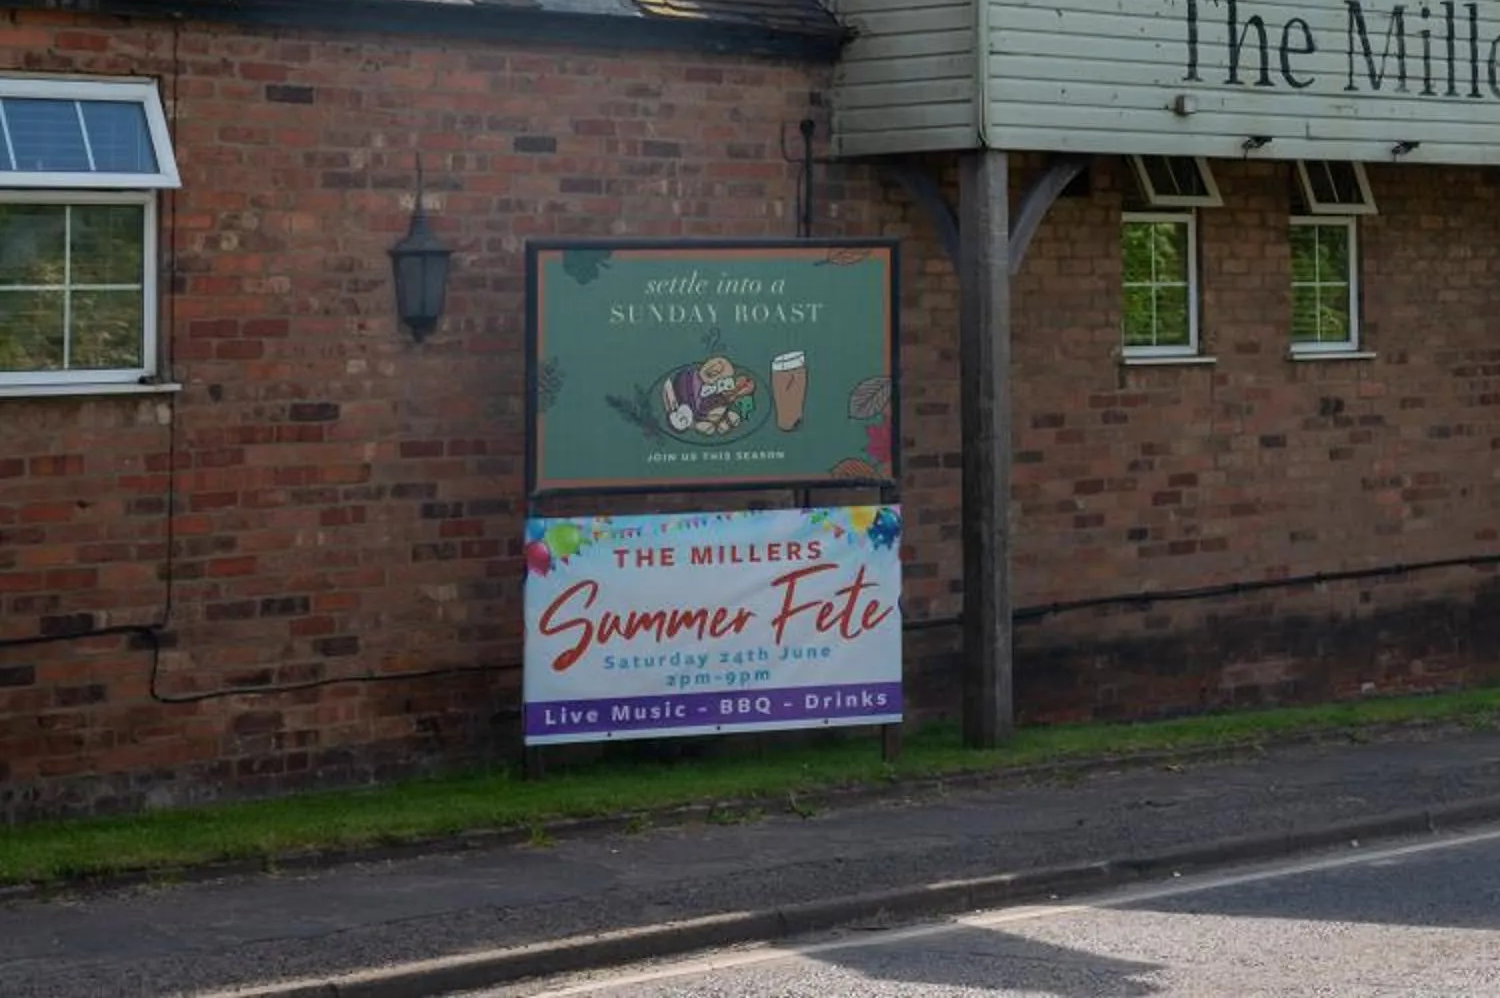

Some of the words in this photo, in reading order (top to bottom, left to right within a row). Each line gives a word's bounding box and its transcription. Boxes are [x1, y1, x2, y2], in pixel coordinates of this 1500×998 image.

[644, 271, 709, 295] settle
[716, 271, 763, 295] into
[769, 278, 786, 295] a
[609, 304, 720, 324] SUNDAY
[735, 303, 825, 323] ROAST
[646, 453, 677, 464] JOIN
[681, 453, 698, 462] US
[702, 451, 731, 461] THIS
[735, 450, 785, 461] SEASON
[613, 547, 675, 569] THE
[690, 540, 824, 566] MILLERS
[538, 578, 757, 673] Summer
[770, 563, 894, 646] Fete
[603, 649, 709, 671] Saturday
[718, 646, 769, 666] 24th
[778, 645, 832, 662] June
[664, 667, 771, 689] 2pm-9pm
[544, 708, 599, 726] Live
[611, 700, 686, 722] Music
[719, 696, 773, 716] BBQ
[804, 691, 888, 710] Drinks
